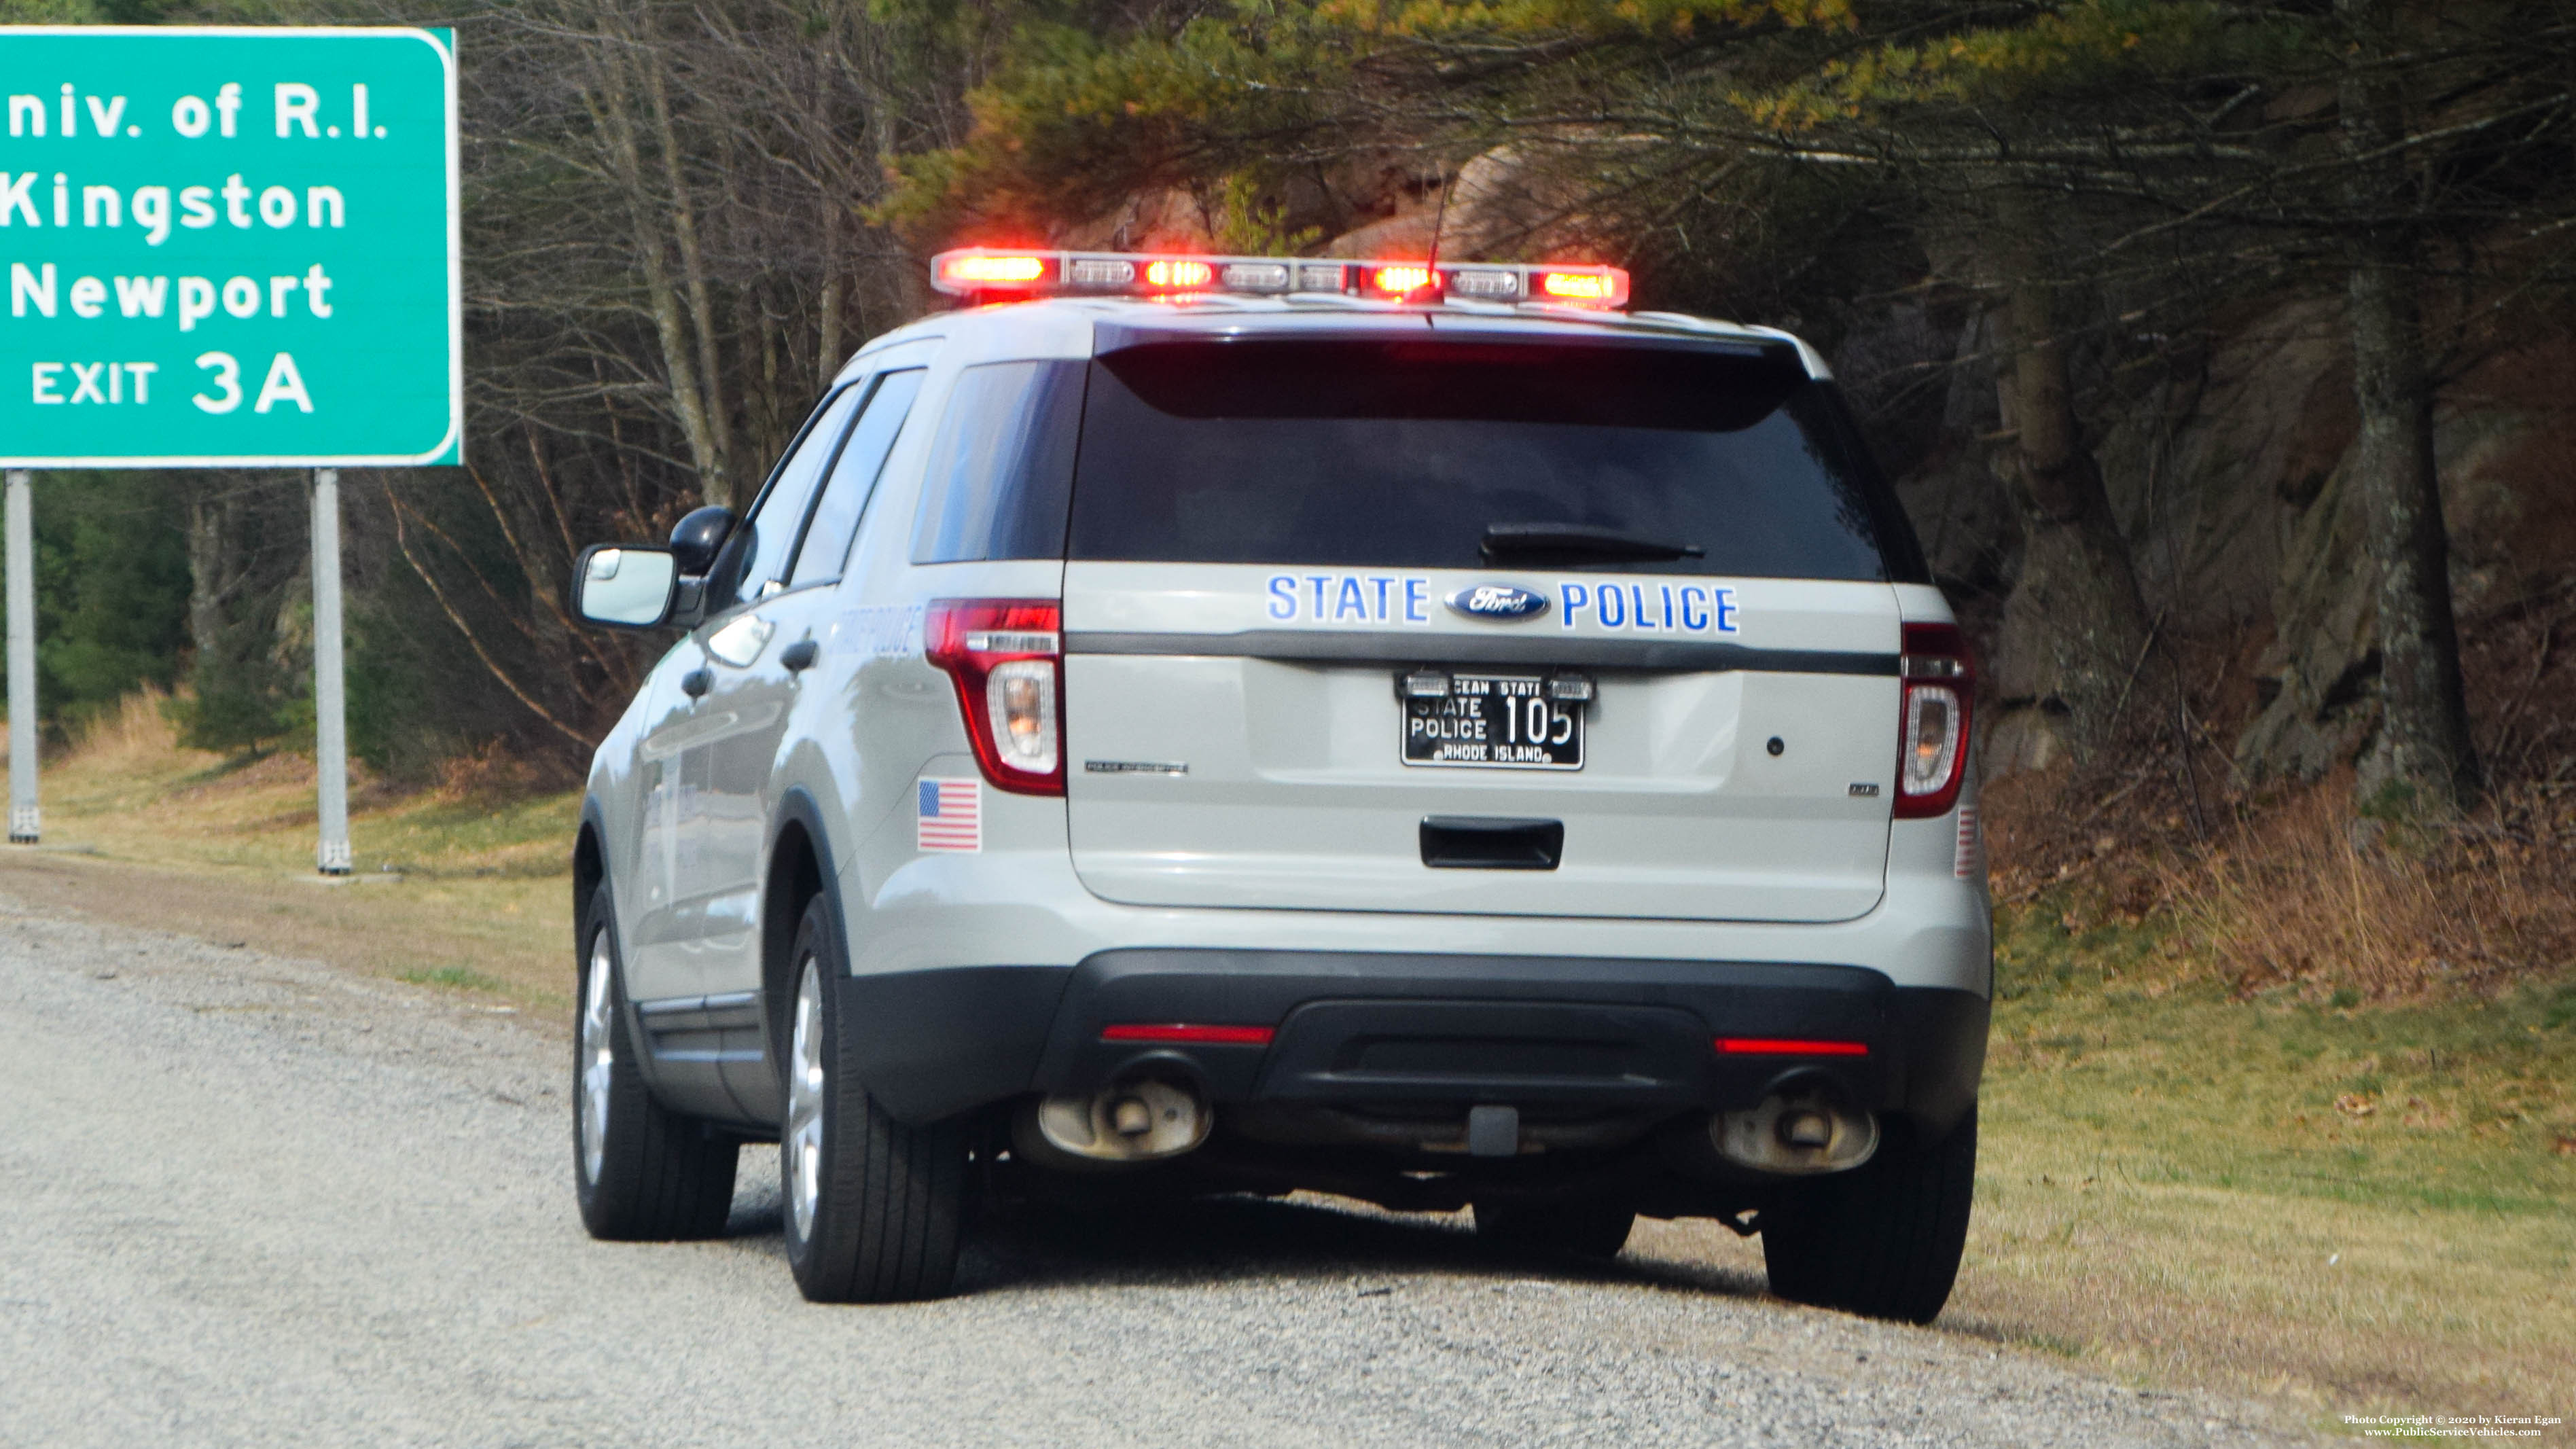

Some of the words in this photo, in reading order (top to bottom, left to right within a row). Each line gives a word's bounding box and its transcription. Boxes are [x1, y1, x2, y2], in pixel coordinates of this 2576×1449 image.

[8, 82, 142, 138] niv.
[172, 82, 243, 138] of
[274, 82, 387, 138] R.I.
[0, 172, 345, 247] Kingston
[10, 262, 333, 332] Newport
[32, 361, 159, 404] EXIT
[192, 351, 315, 414] 3A
[1268, 575, 1428, 622] STATE
[1560, 582, 1738, 632] POLICE
[1469, 586, 1528, 612] Ford
[1413, 697, 1482, 718] STATE
[1454, 680, 1490, 695] CEAN
[1411, 718, 1488, 740] POLICE
[1505, 695, 1572, 745] 105
[1444, 745, 1488, 761] RHODE
[1495, 745, 1543, 762] ISLAND
